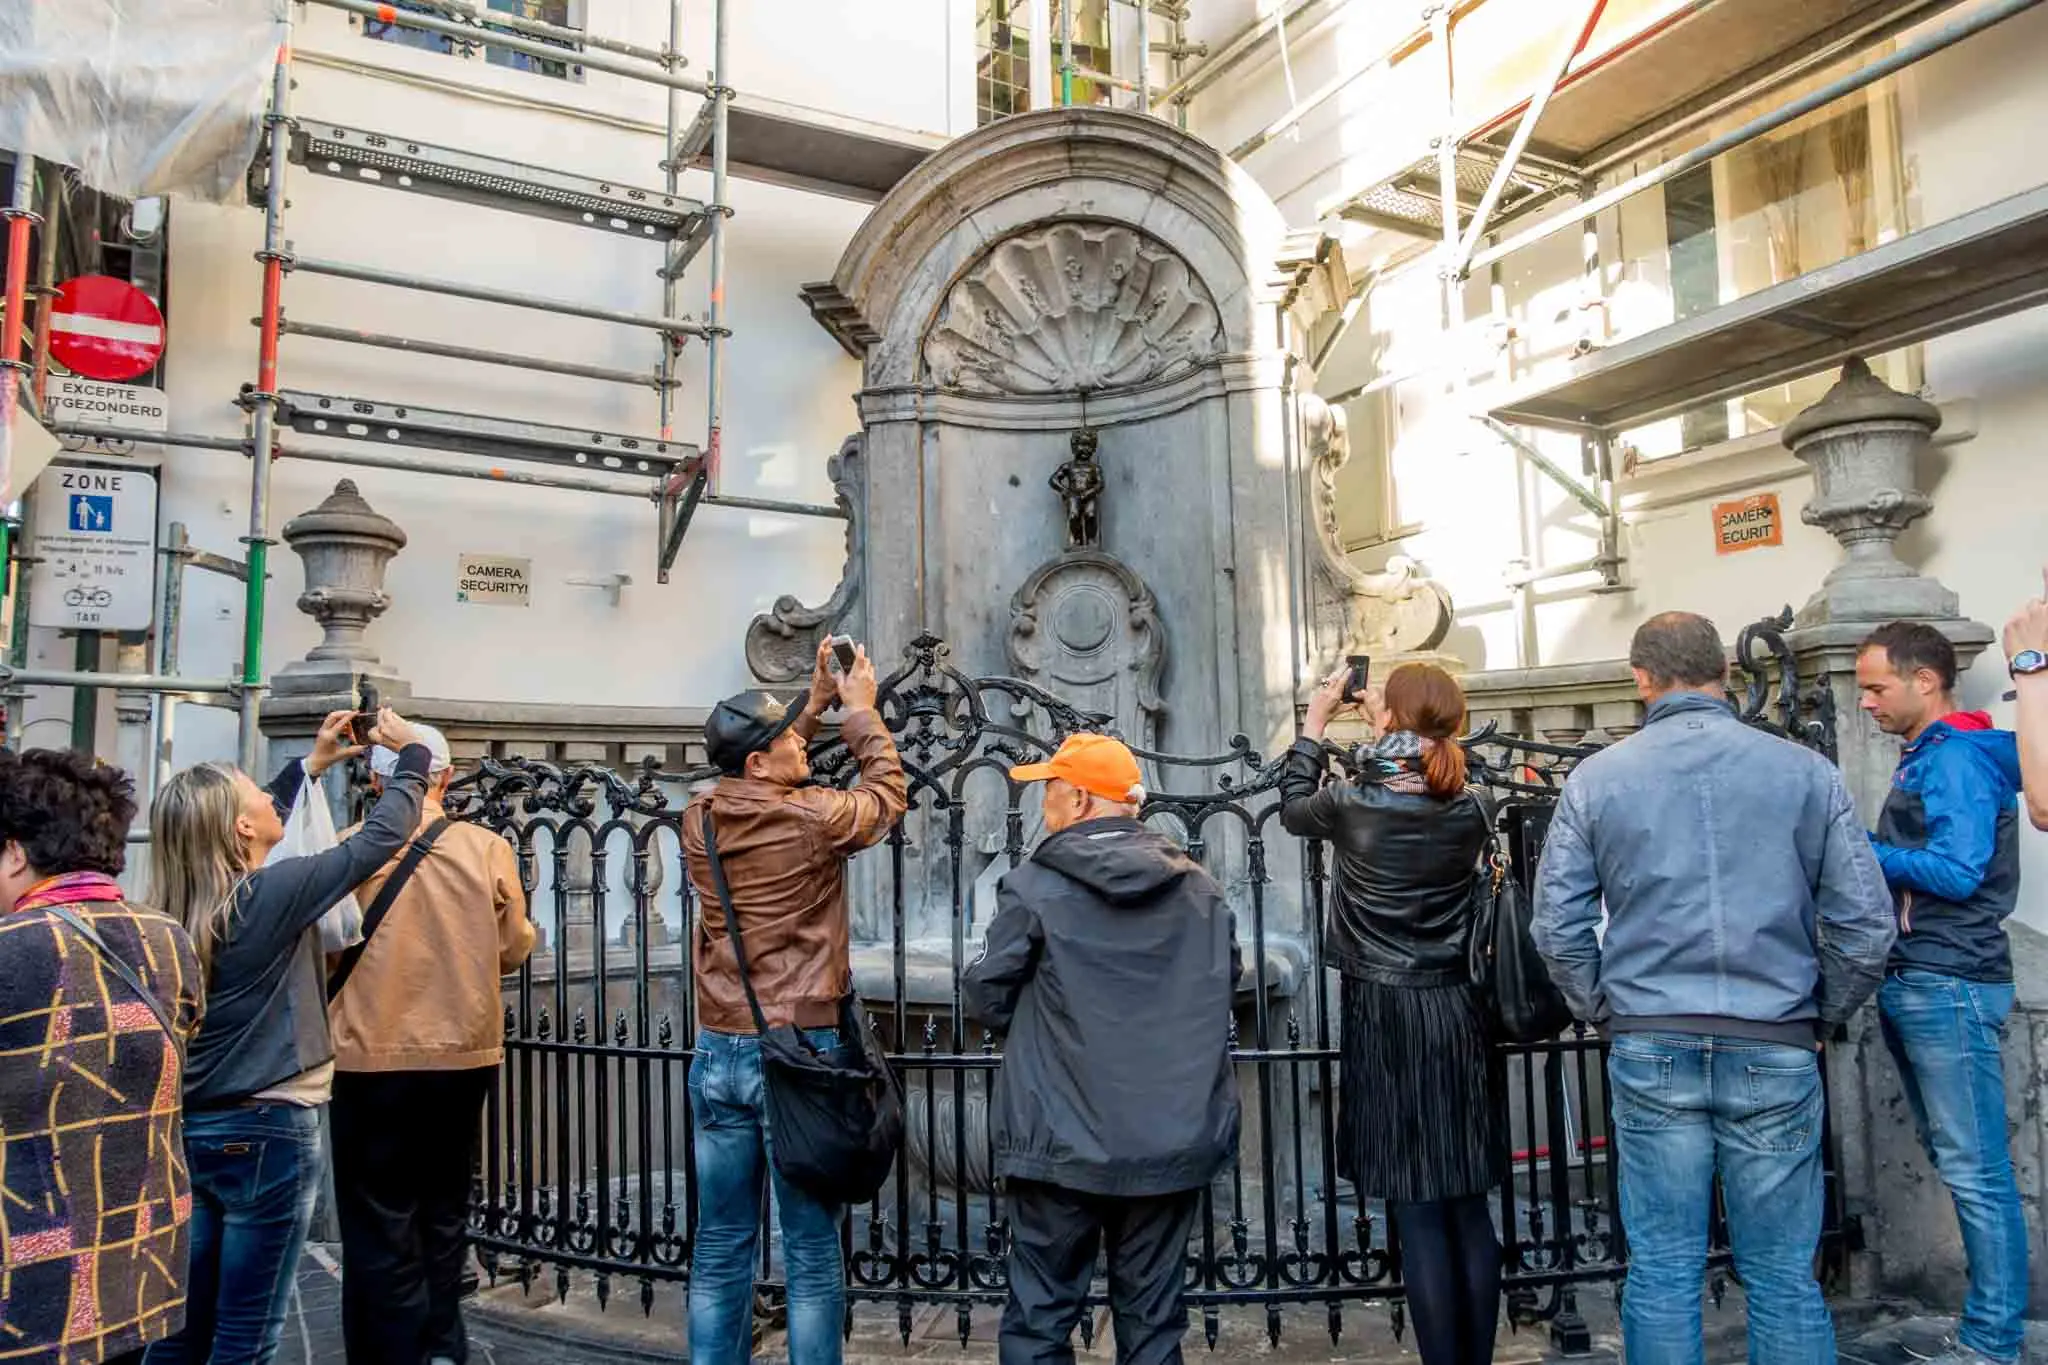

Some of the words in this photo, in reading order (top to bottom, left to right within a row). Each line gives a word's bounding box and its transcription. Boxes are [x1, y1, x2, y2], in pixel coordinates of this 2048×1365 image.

[63, 383, 137, 400] EXCEPTE
[62, 473, 121, 491] ZONE
[1720, 506, 1773, 527] CAMER
[1722, 524, 1773, 544] ECURIT
[467, 565, 522, 578] CAMERA
[460, 579, 528, 595] SECURITY!
[76, 611, 101, 622] TAXI
